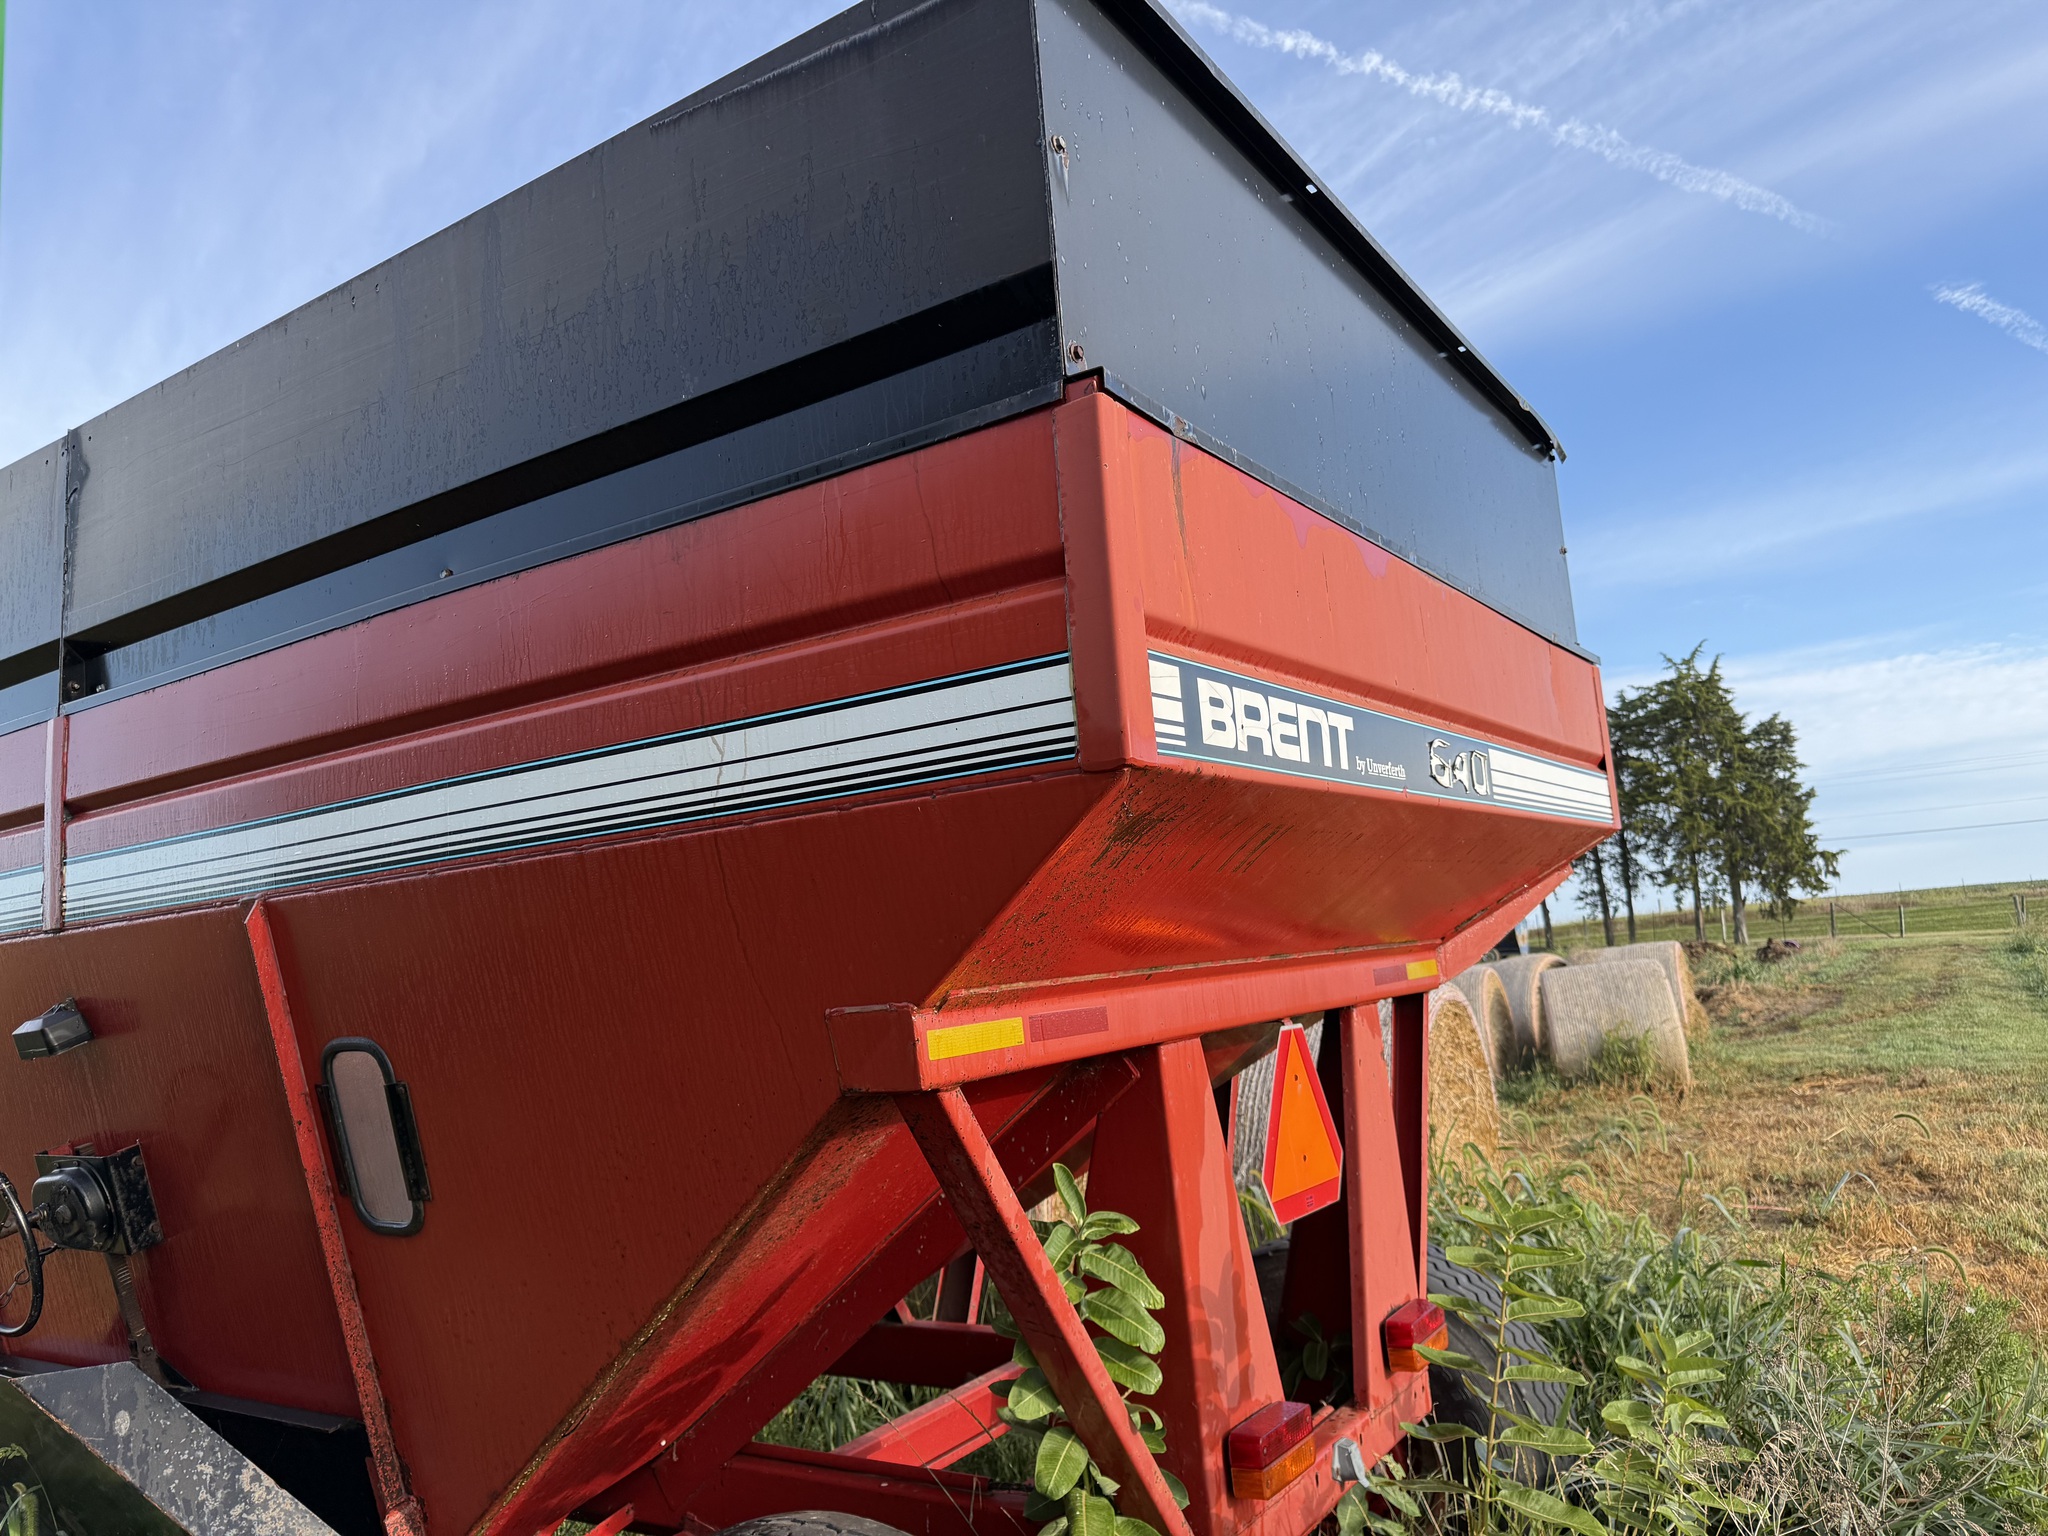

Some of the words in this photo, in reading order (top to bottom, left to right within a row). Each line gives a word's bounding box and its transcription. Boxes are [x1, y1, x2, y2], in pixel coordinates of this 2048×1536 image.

[1196, 677, 1354, 770] BRENT
[1355, 756, 1366, 775] by
[1366, 758, 1406, 780] Unverferth
